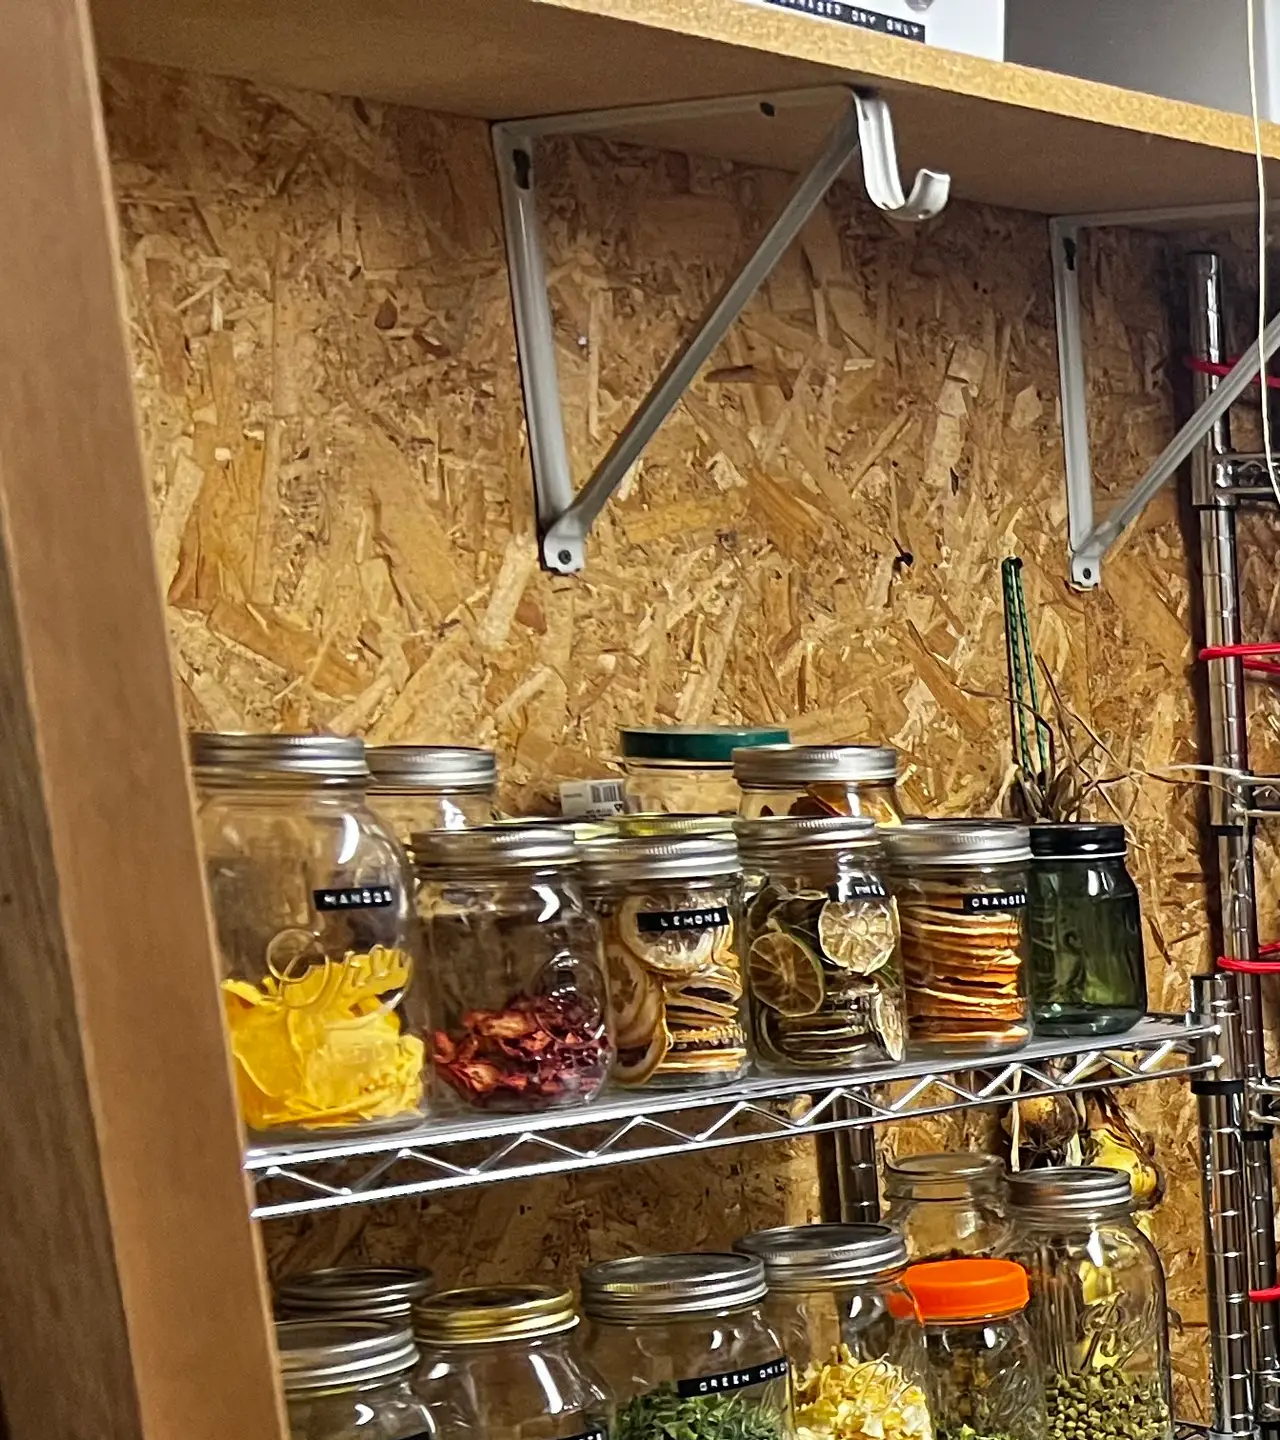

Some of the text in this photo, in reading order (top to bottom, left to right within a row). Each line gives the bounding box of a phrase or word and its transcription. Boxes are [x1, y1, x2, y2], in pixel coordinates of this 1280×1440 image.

[971, 894, 1026, 908] ORANGES
[660, 912, 721, 928] LEMONS
[699, 1374, 750, 1391] GREEN
